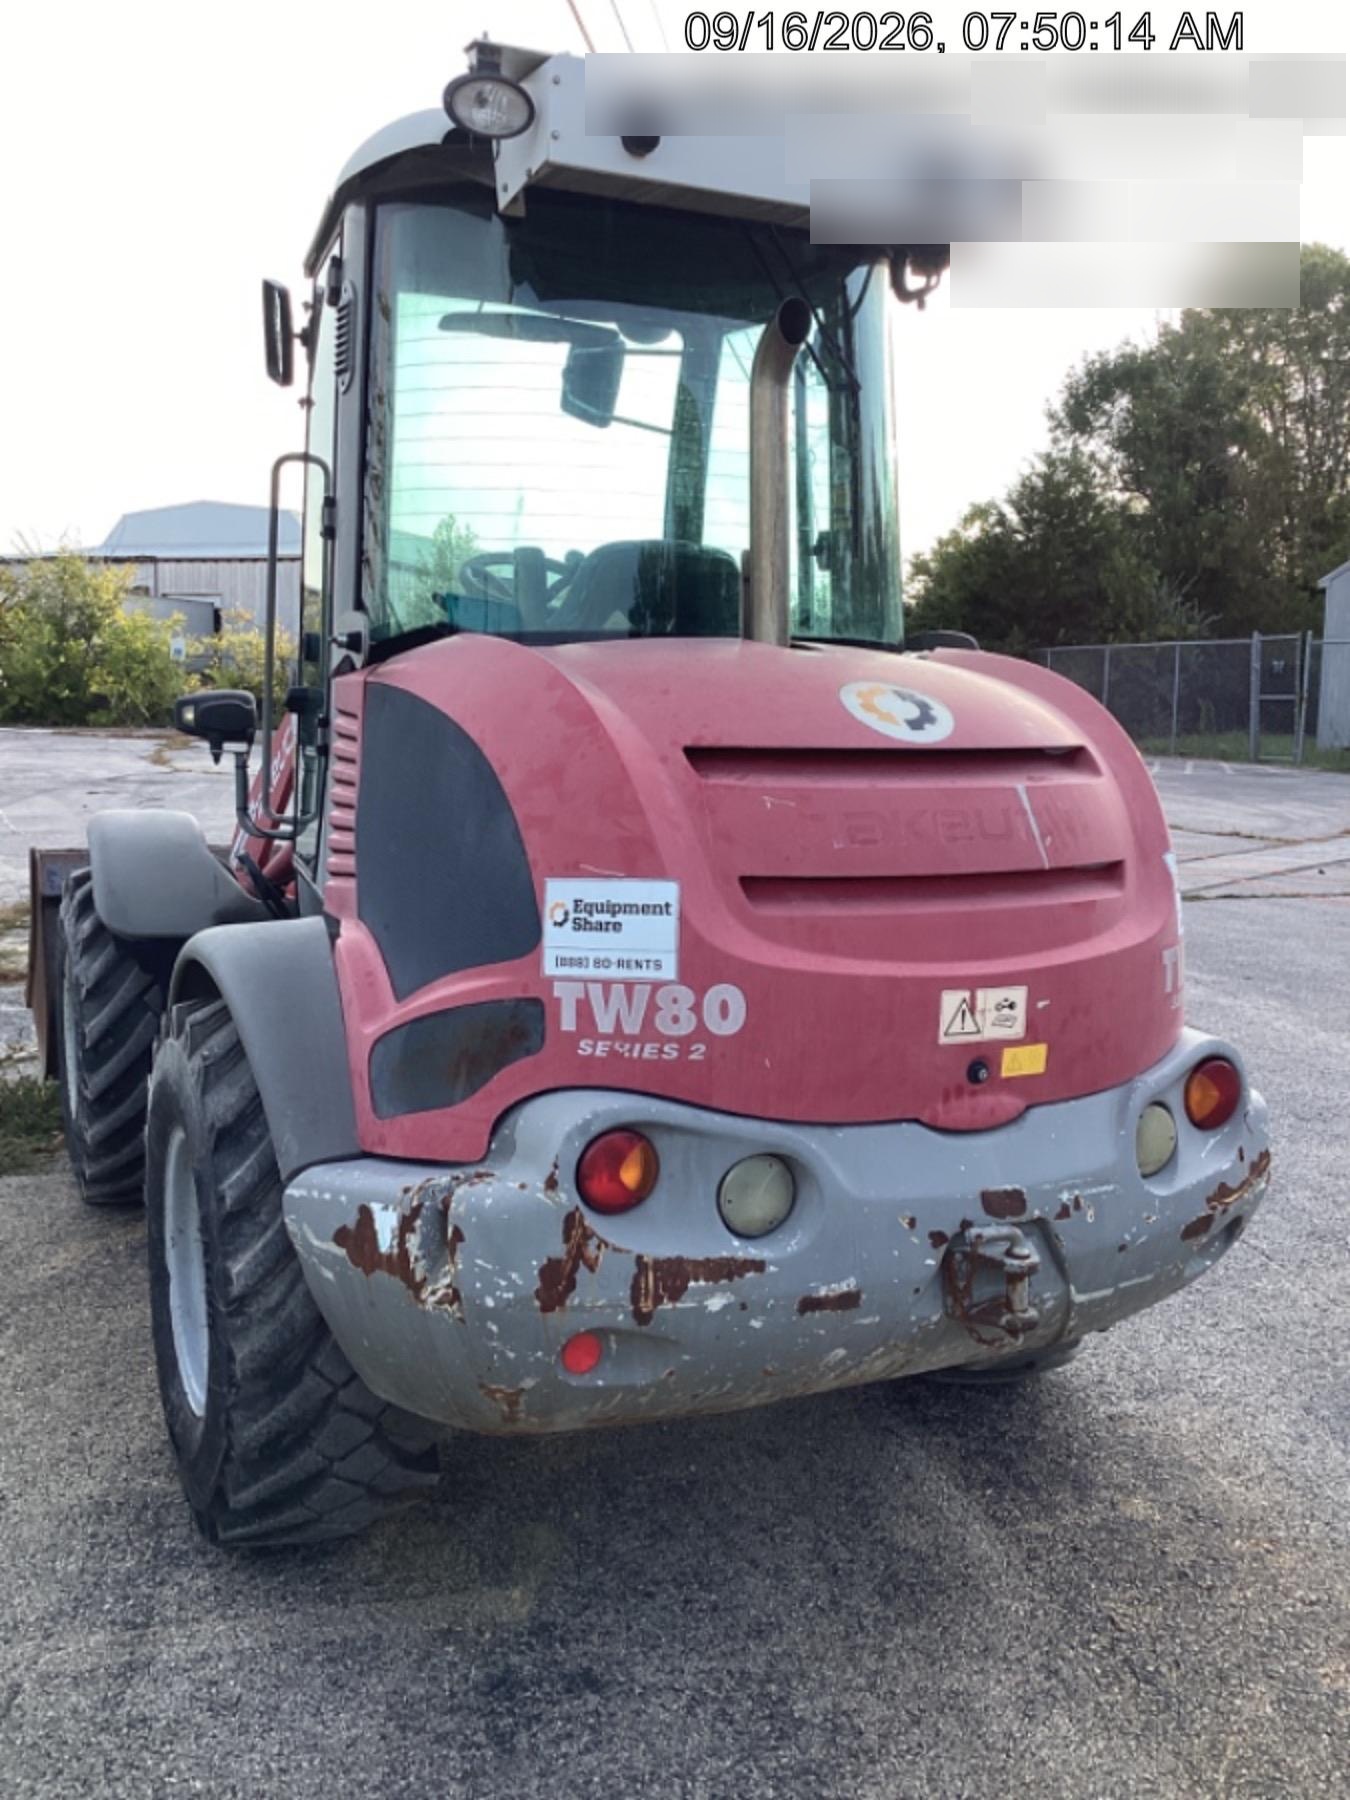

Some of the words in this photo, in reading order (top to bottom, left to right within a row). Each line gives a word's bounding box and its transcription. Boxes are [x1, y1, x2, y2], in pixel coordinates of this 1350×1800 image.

[572, 899, 673, 917] Equipment
[571, 916, 623, 933] Share
[553, 981, 747, 1036] TW80
[687, 1042, 706, 1061] 2
